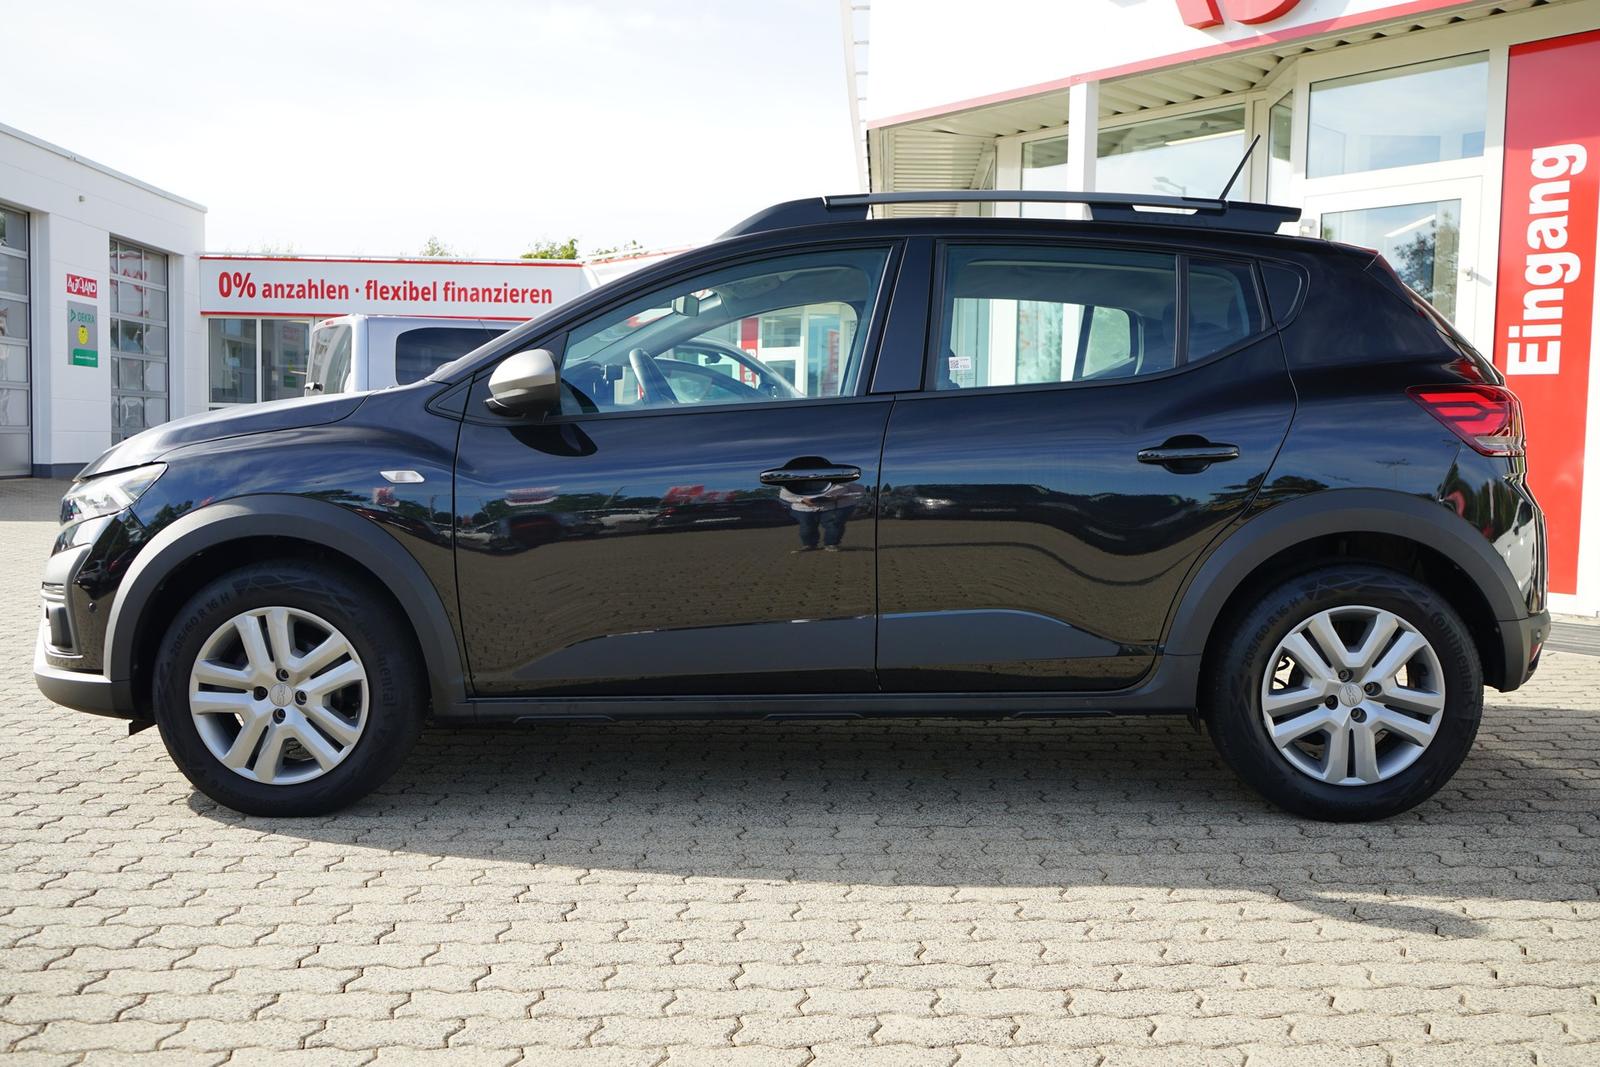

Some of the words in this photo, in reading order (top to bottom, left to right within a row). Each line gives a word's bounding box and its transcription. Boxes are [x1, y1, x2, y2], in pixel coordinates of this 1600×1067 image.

[218, 271, 257, 298] 0%
[261, 278, 350, 300] anzahlen
[365, 280, 437, 302] flexibel
[443, 281, 553, 304] finanzieren
[1506, 143, 1588, 375] Eingang
